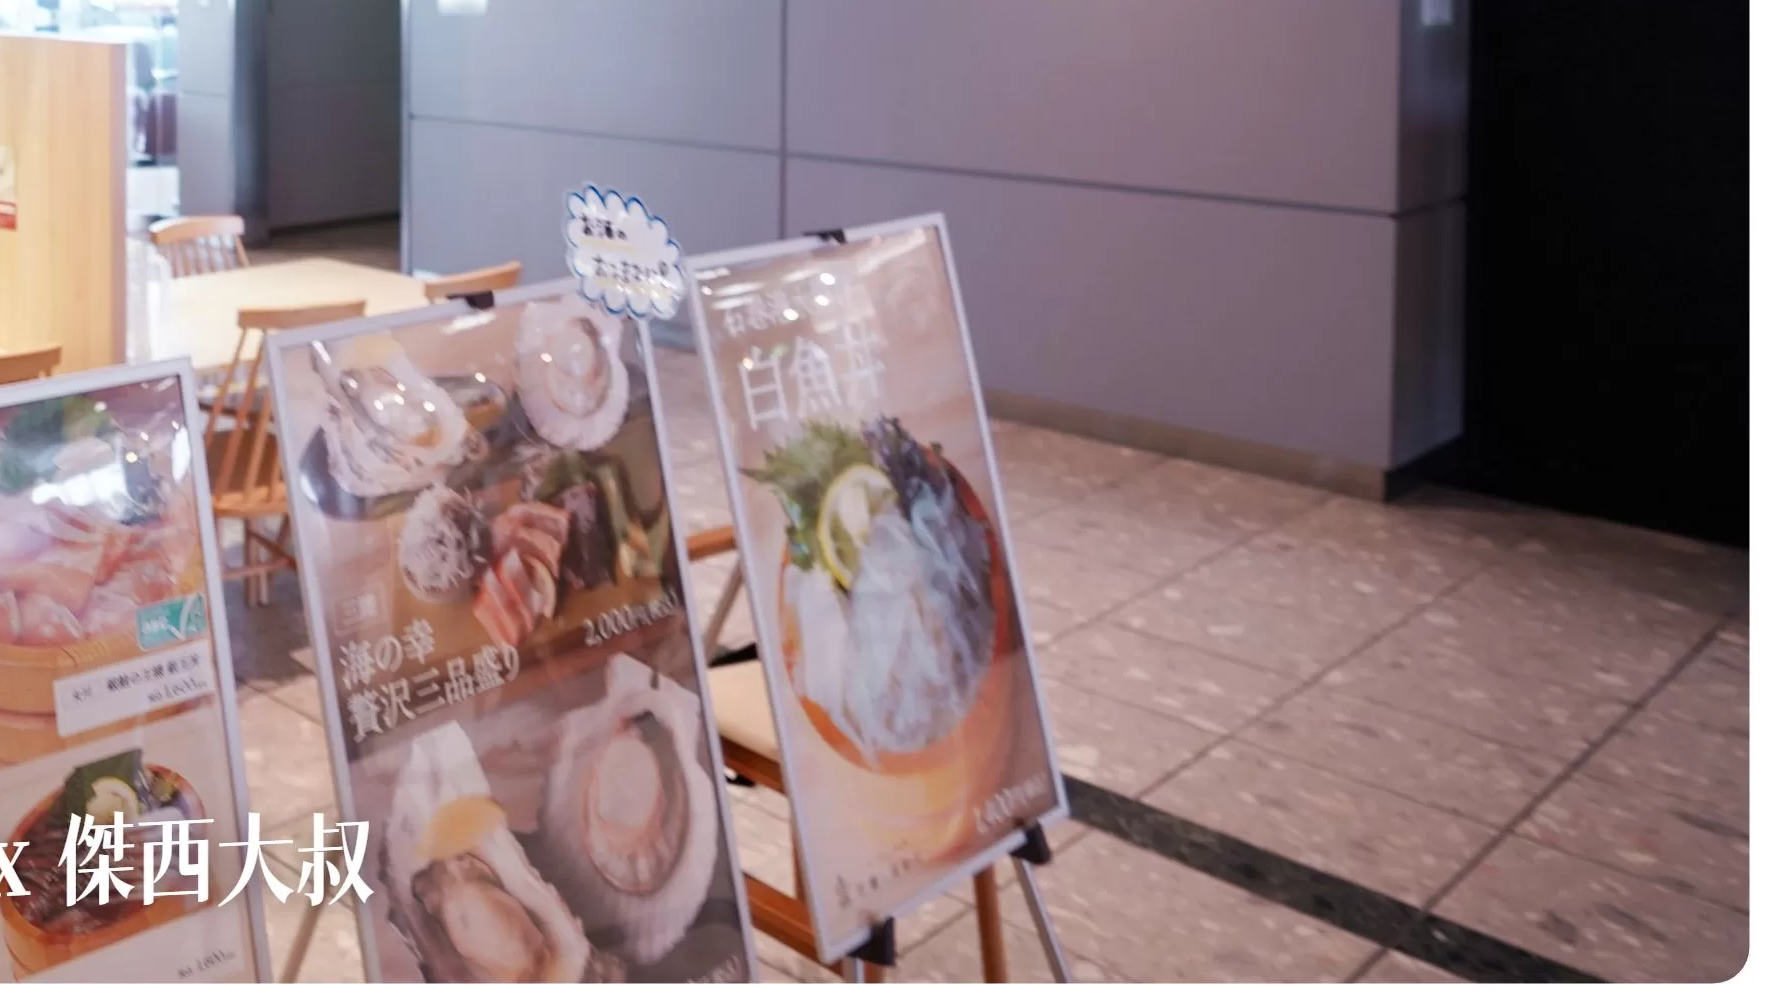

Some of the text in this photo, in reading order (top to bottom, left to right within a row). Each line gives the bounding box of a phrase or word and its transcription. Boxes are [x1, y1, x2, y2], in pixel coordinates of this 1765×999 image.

[739, 321, 888, 431] 白魚丼
[340, 618, 436, 690] 海の幸
[347, 642, 521, 743] 贅沢三品盛り
